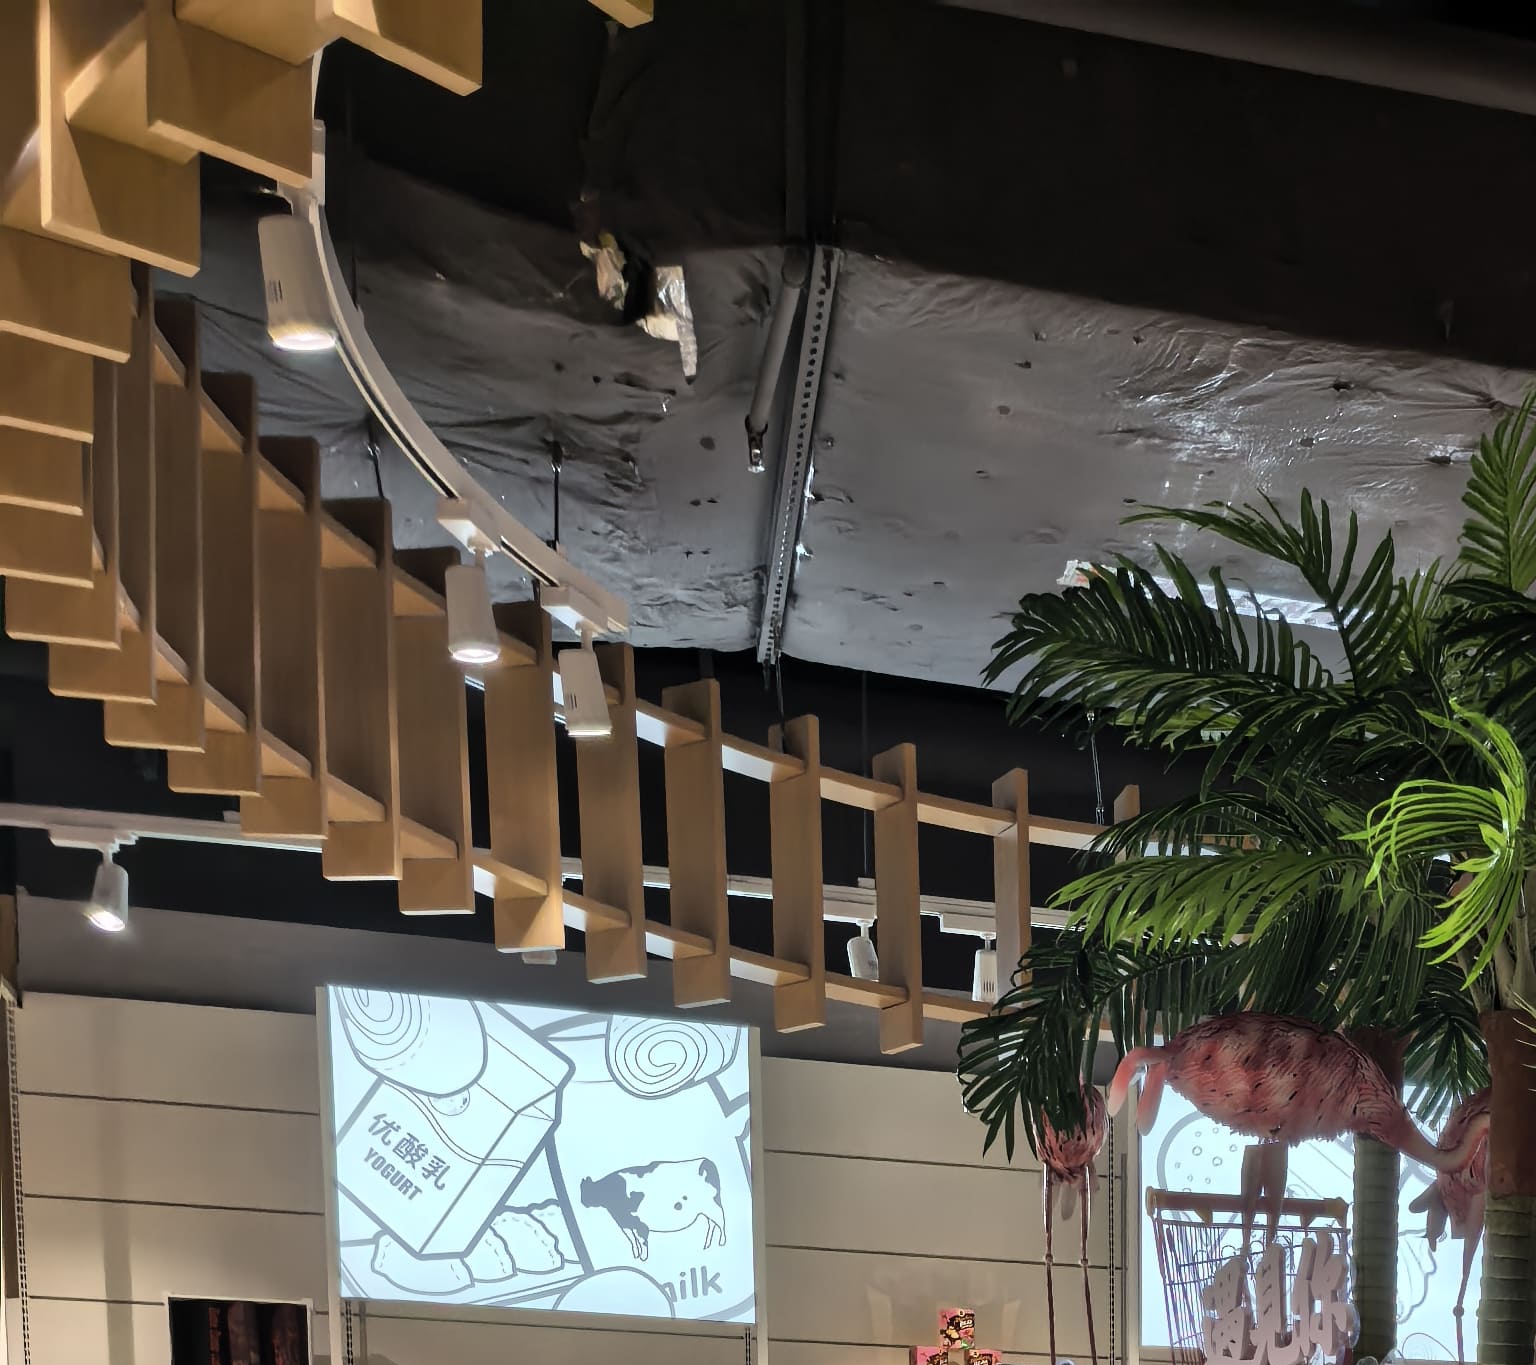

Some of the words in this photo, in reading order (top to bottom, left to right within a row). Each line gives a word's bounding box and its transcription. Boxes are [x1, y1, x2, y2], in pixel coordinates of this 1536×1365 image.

[363, 1148, 423, 1201] YOGURT
[368, 1112, 450, 1191] 优酸乳
